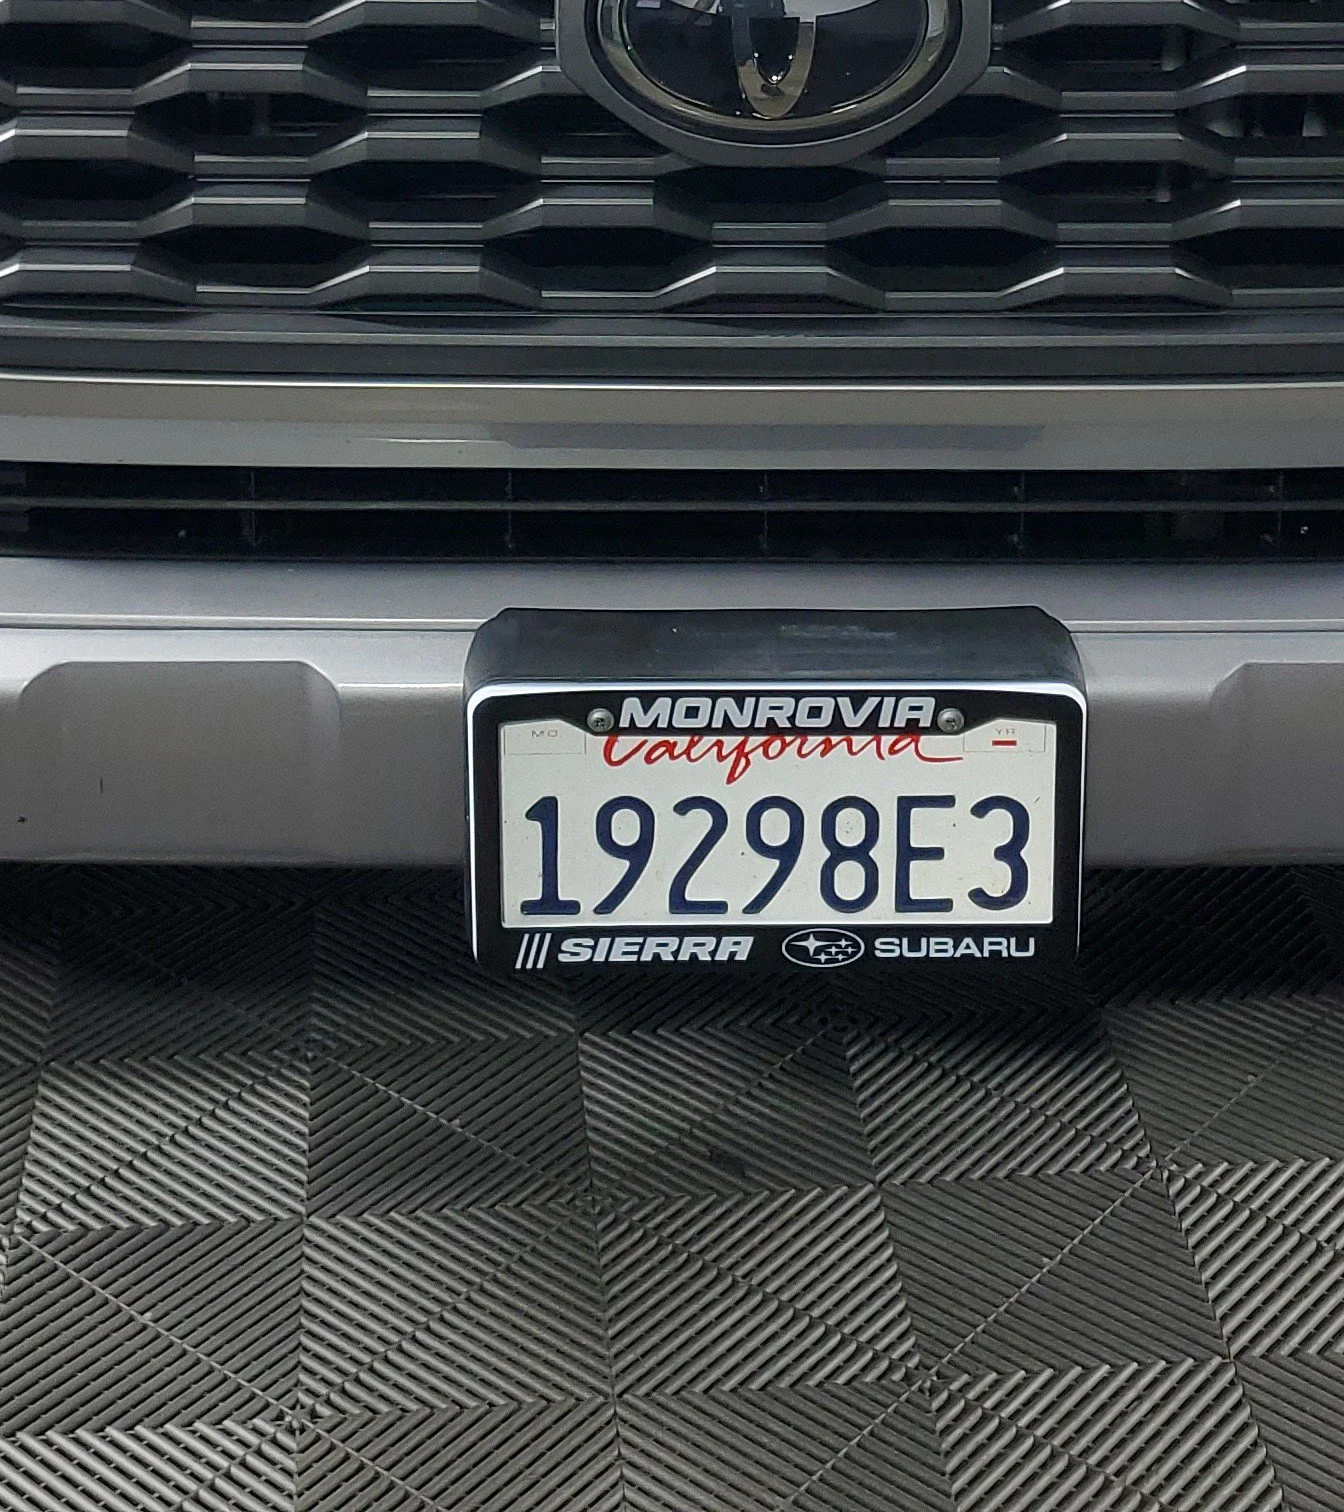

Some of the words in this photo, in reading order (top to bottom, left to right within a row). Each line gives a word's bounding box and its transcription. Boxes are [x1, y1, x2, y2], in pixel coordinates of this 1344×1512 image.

[618, 696, 936, 729] MONROVIA
[520, 795, 1030, 915] 19298E3
[557, 936, 755, 963] SIERRA
[874, 936, 1035, 958] SUBARU
